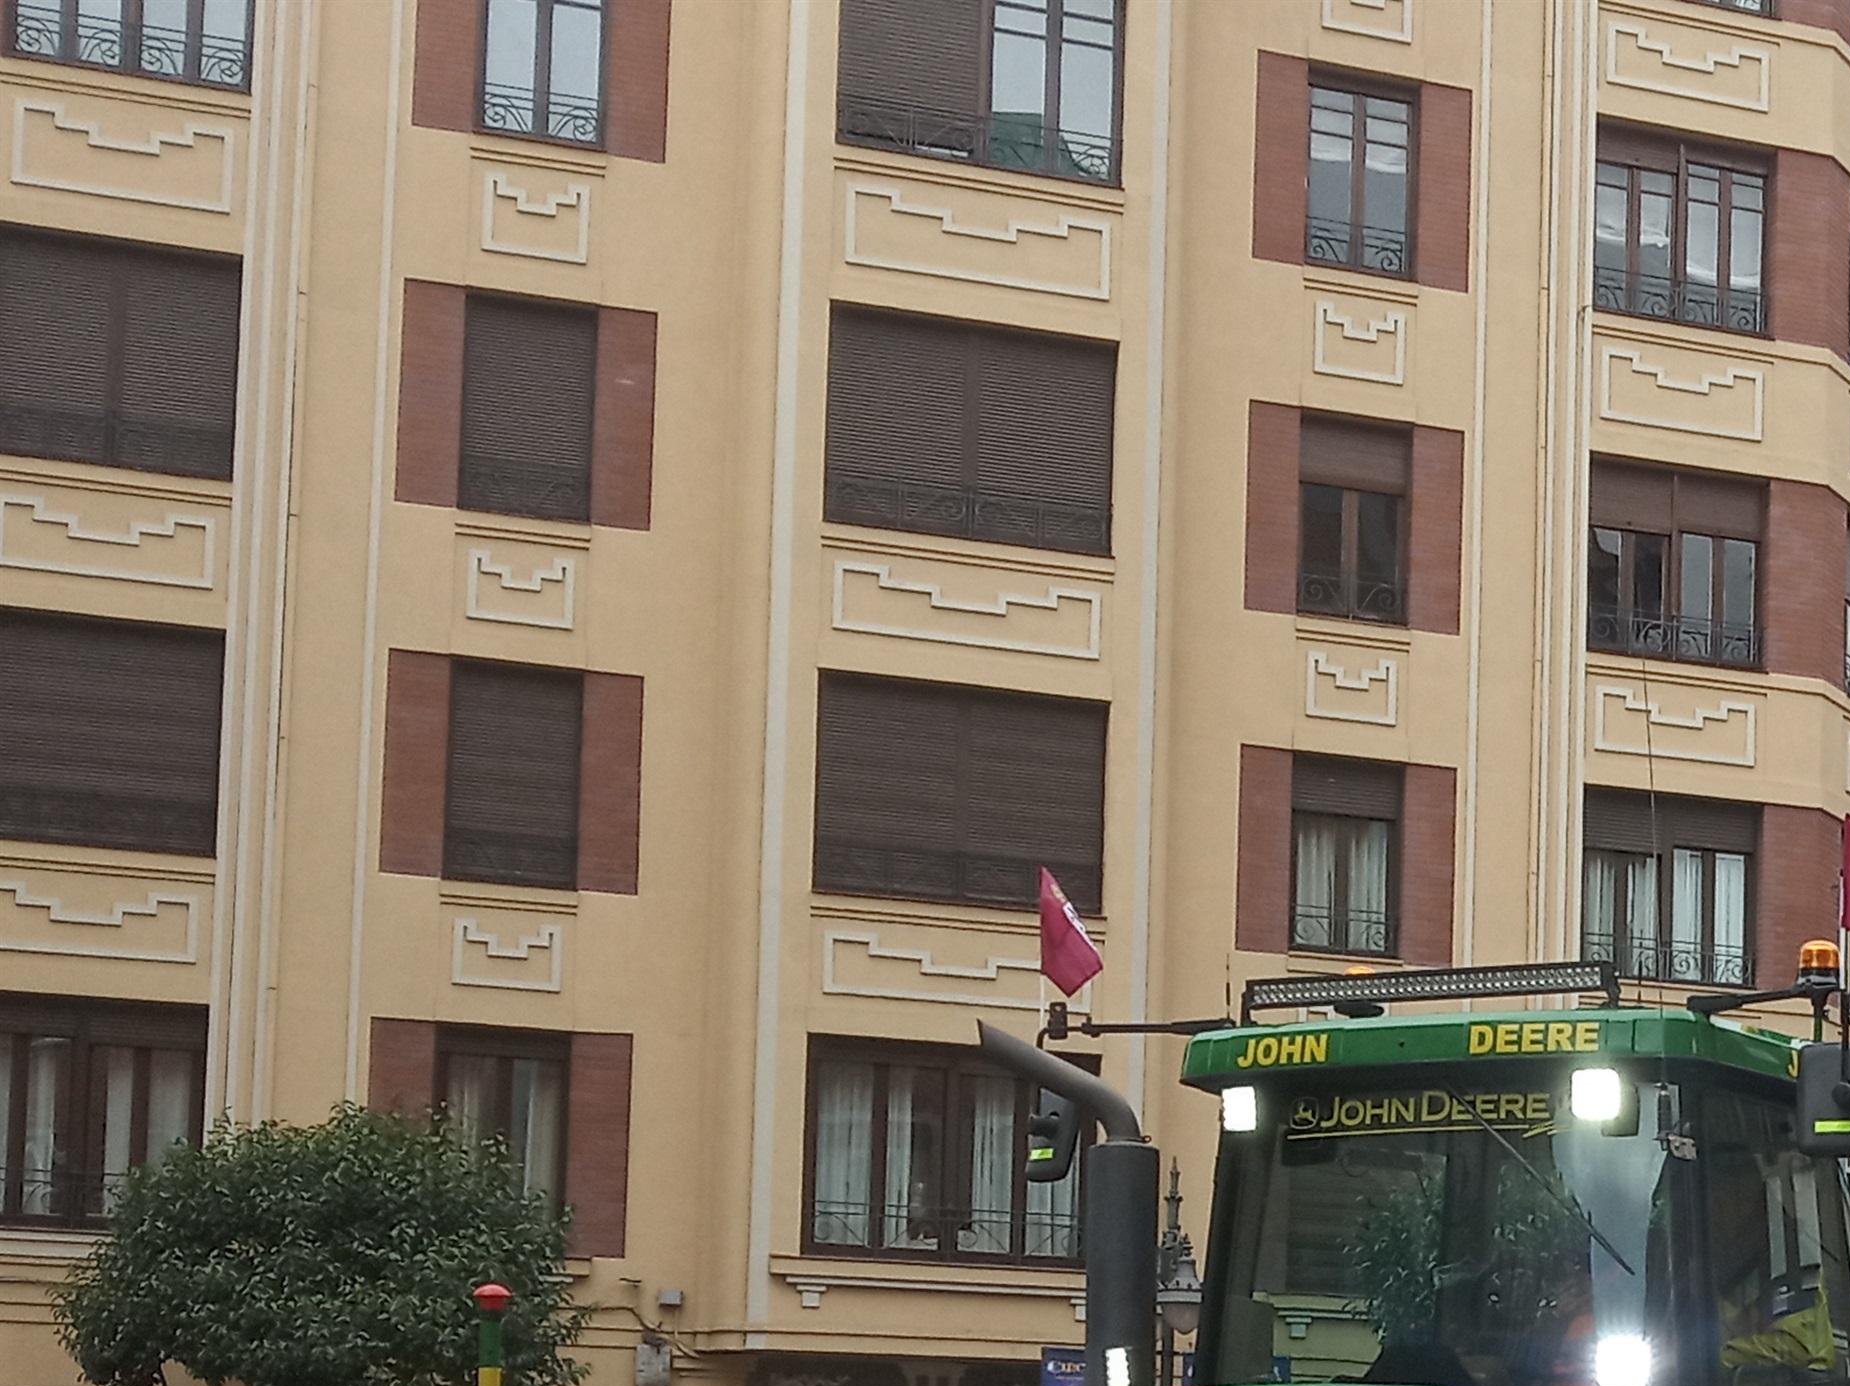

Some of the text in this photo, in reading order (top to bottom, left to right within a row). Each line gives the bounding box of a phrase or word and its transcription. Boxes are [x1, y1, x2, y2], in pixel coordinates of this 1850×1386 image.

[1237, 1022, 1601, 1068] JOHN DEERE
[1320, 1089, 1551, 1128] JOHN DEERE
